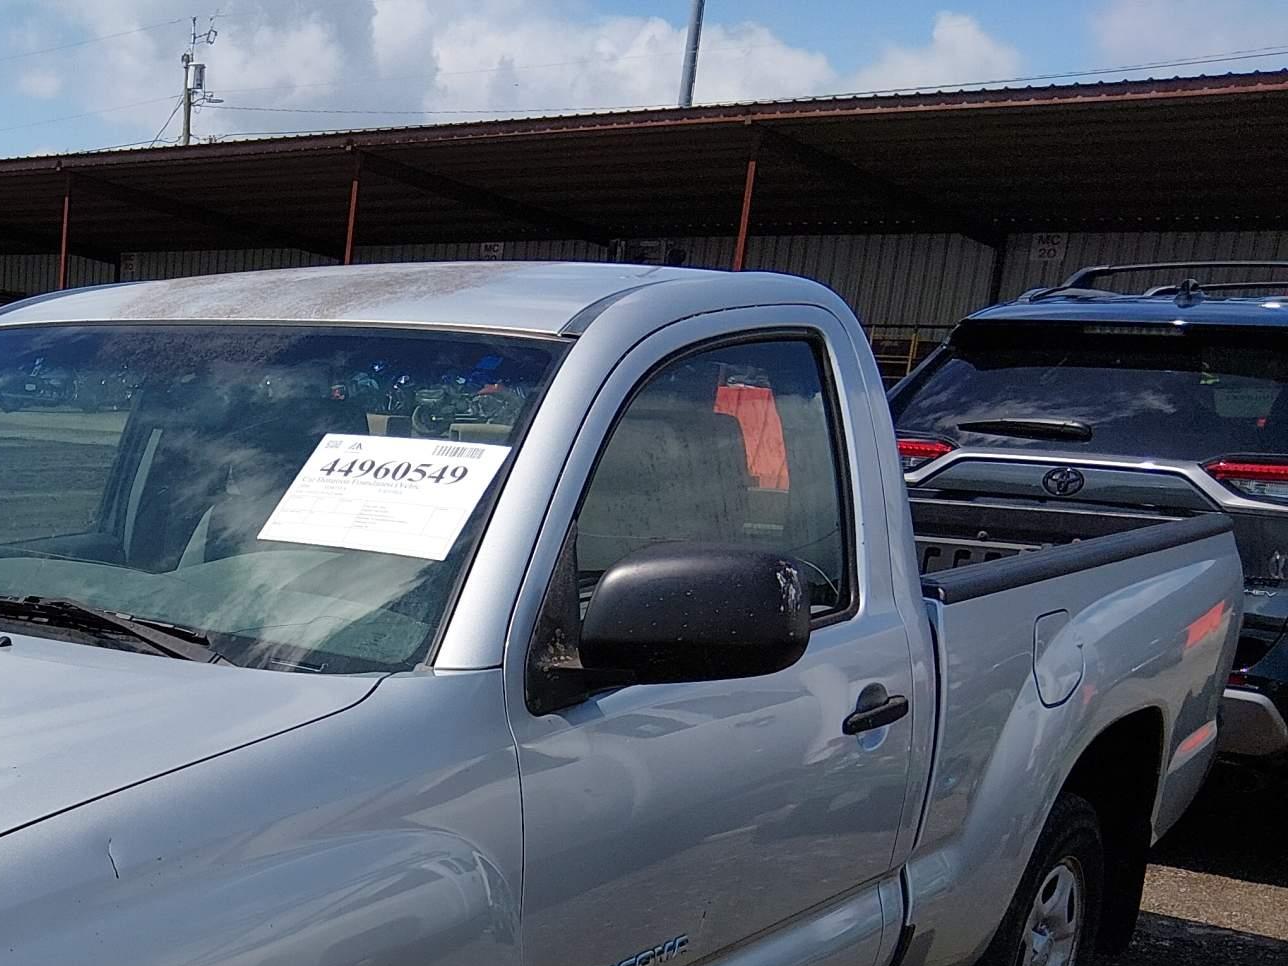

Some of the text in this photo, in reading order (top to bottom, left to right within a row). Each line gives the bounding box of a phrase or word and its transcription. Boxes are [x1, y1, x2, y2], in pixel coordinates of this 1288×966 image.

[1038, 234, 1061, 245] MC
[1038, 248, 1057, 258] 20
[320, 457, 469, 485] 44960549
